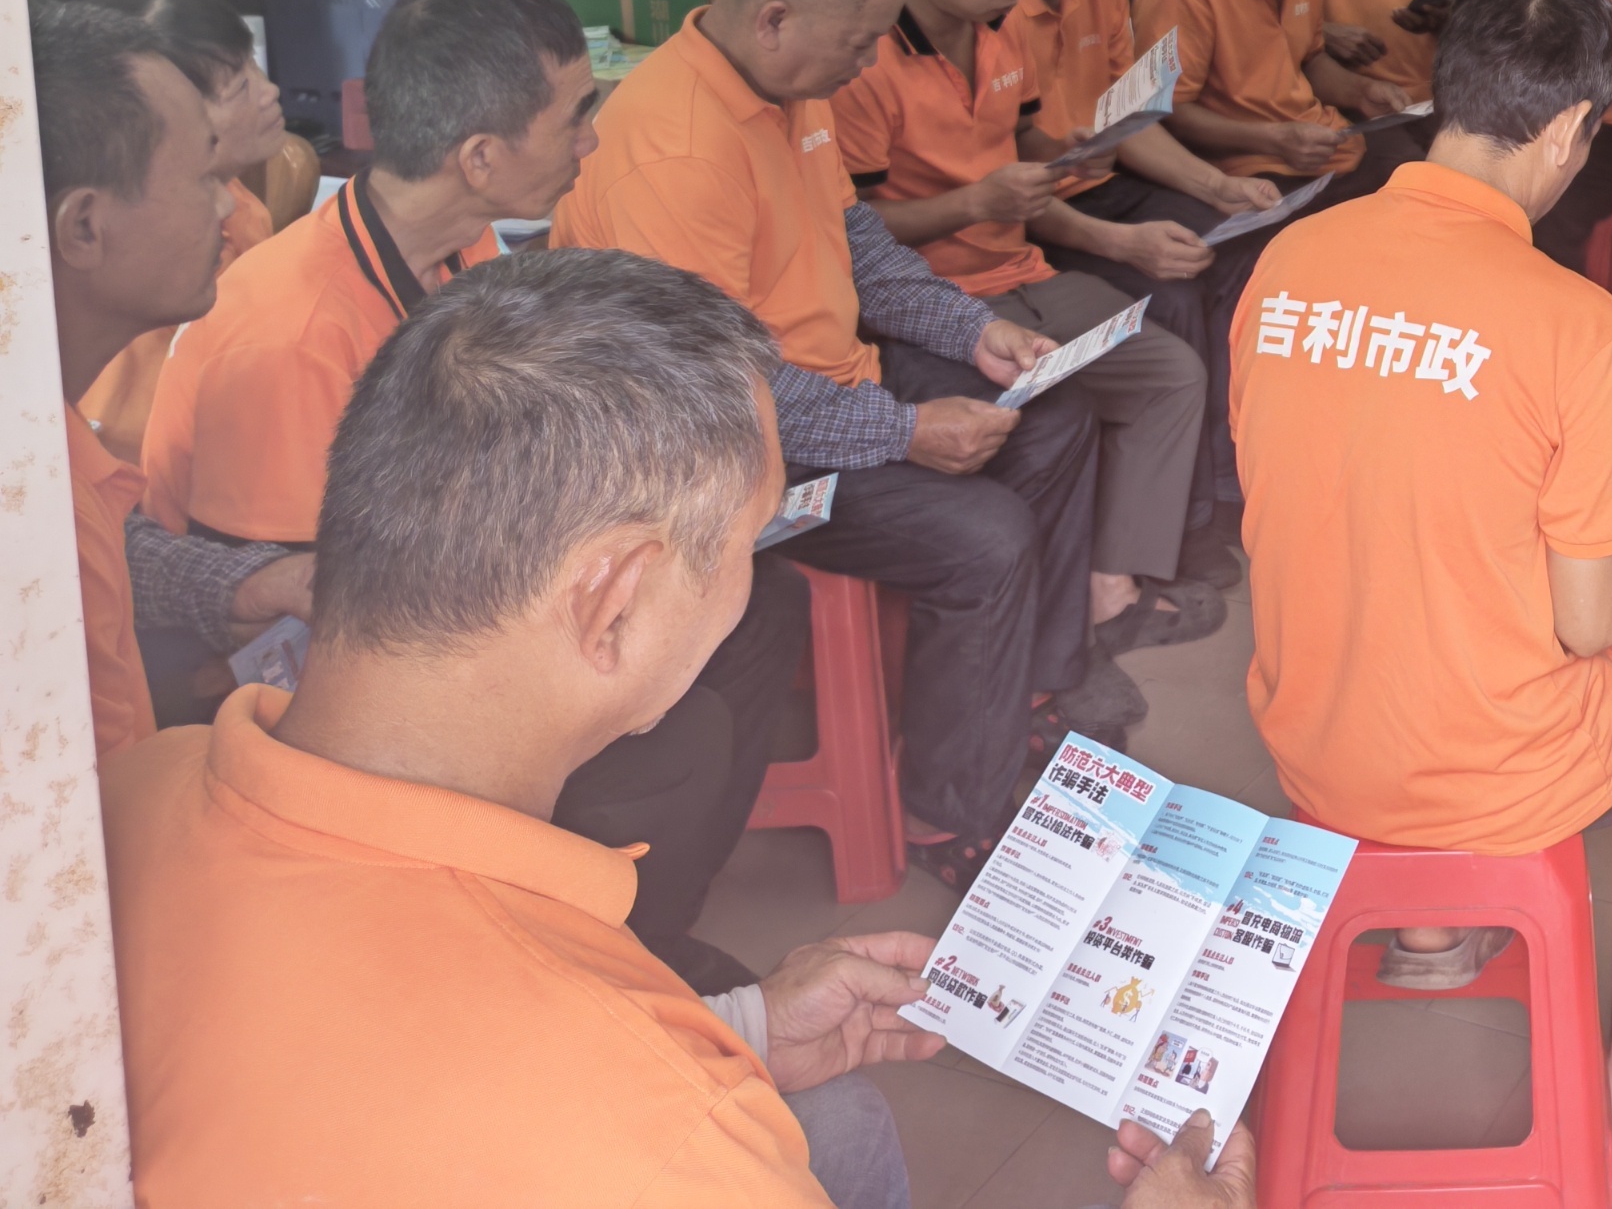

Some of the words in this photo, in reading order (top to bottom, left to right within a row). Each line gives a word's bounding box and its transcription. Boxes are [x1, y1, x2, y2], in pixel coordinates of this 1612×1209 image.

[1256, 290, 1492, 401] 吉利市政
[1048, 763, 1109, 805] 诈骗手法
[1058, 743, 1153, 803] 防范六大典型
[1022, 805, 1096, 850] 冒充公检法诈骗
[1043, 803, 1089, 831] IMPERSONATION
[1106, 926, 1143, 948] INVESTMENT
[1232, 928, 1275, 954] 客服诈骗
[1241, 910, 1304, 944] 冒充电商物流
[1083, 930, 1156, 970] 投资平台类诈骗
[927, 967, 988, 1010] 网络贷款诈骗
[934, 955, 958, 972] #2
[950, 965, 981, 987] NETWORK
